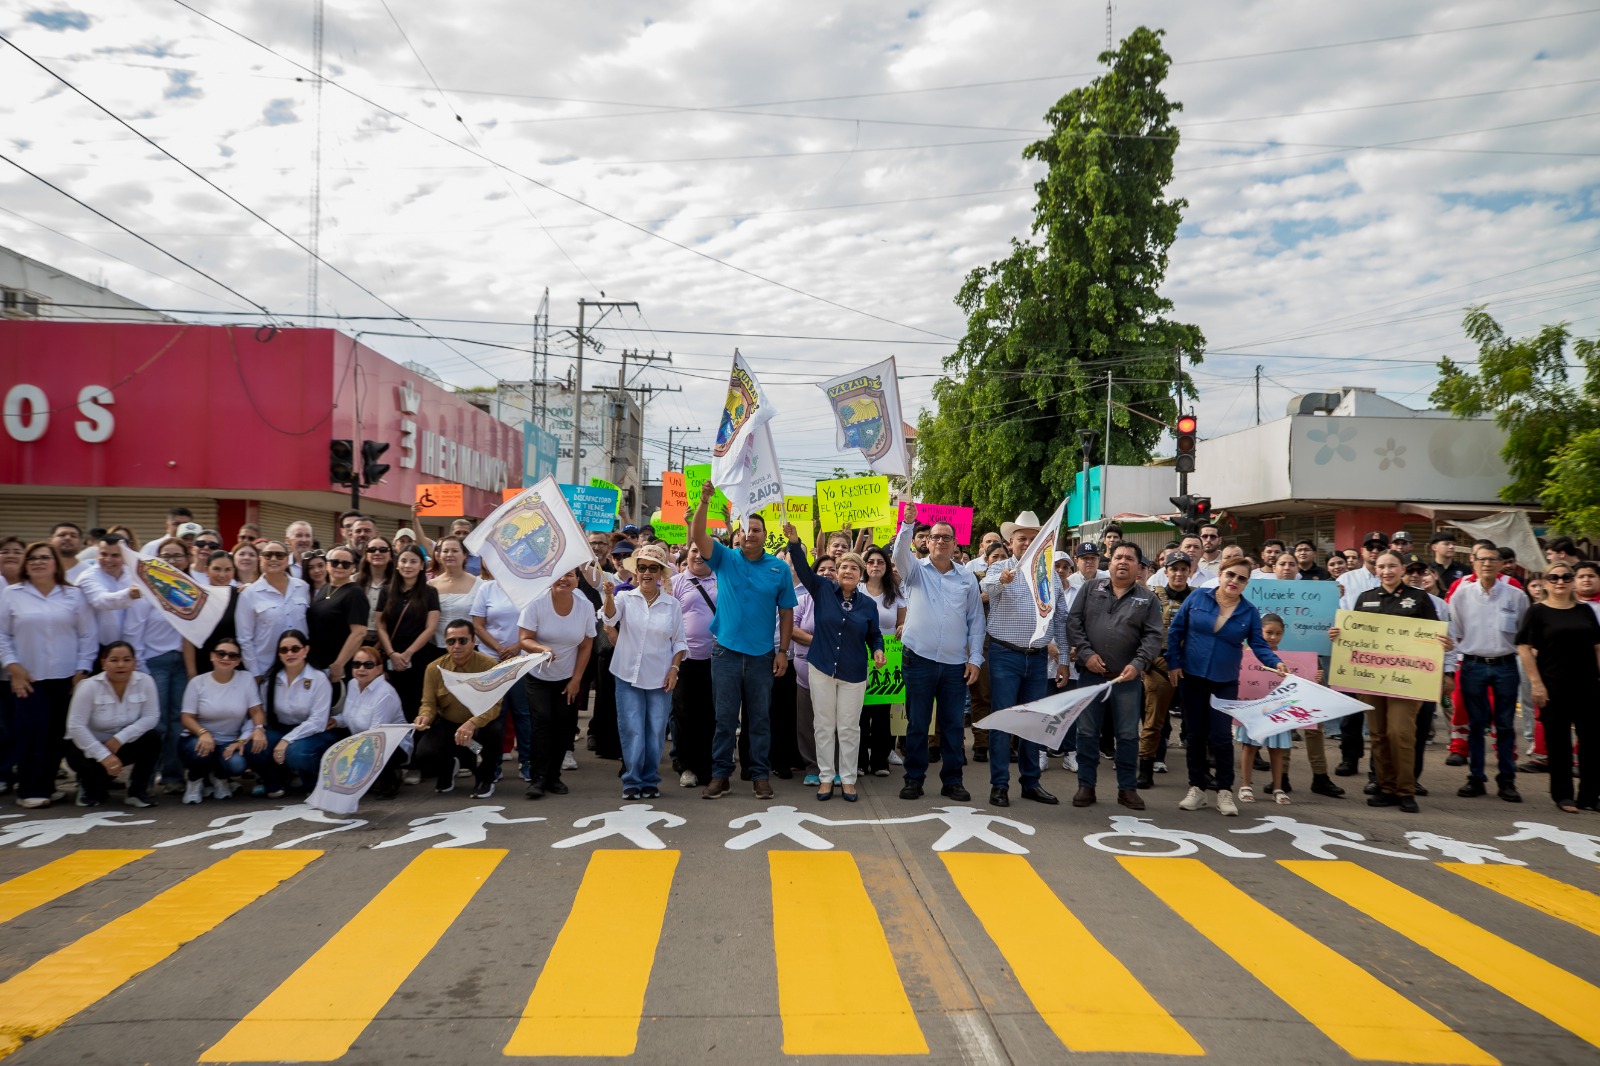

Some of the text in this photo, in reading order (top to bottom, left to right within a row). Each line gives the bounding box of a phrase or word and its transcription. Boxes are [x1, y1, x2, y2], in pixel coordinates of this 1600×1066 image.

[400, 419, 508, 493] 3 HERMANOS
[670, 477, 682, 487] UN
[1386, 627, 1395, 635] es
[1351, 650, 1435, 672] RESPONSABILIDAD
[1337, 665, 1347, 675] de
